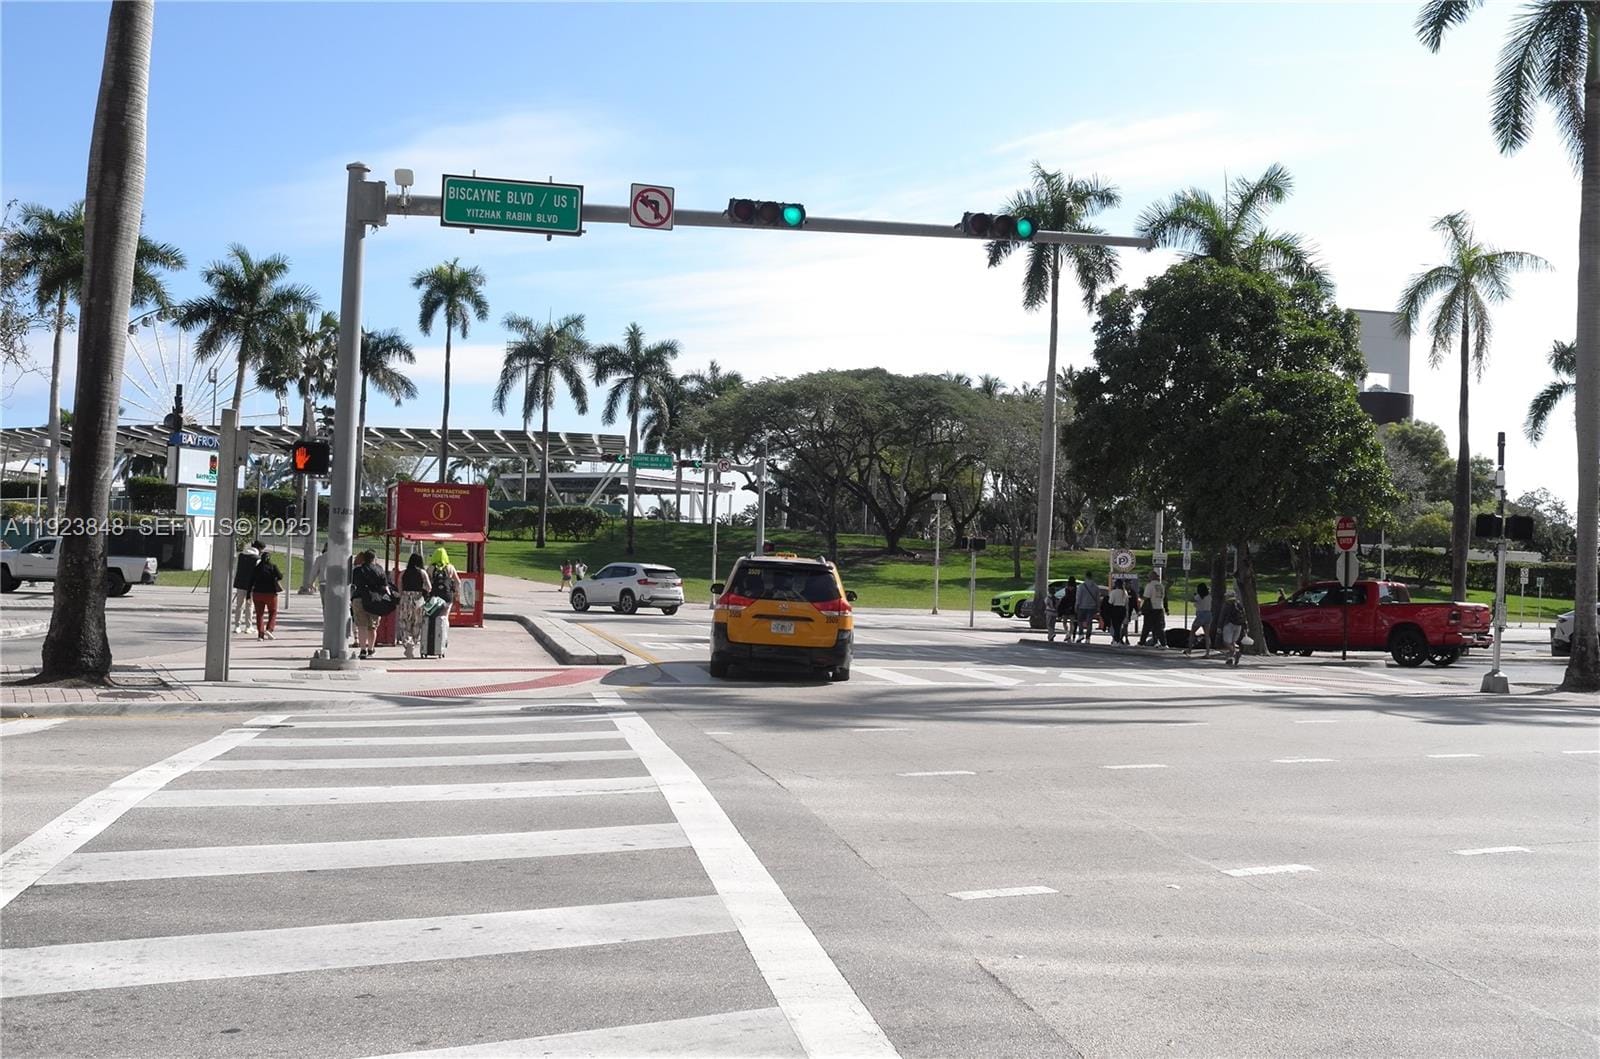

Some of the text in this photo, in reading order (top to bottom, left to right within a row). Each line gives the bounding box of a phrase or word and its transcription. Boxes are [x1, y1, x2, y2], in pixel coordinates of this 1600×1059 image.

[449, 186, 577, 209] BISCAYNE BLVD / US 1
[466, 208, 558, 224] YITZHAK RABIN BLVD
[181, 434, 220, 447] BAYFRON
